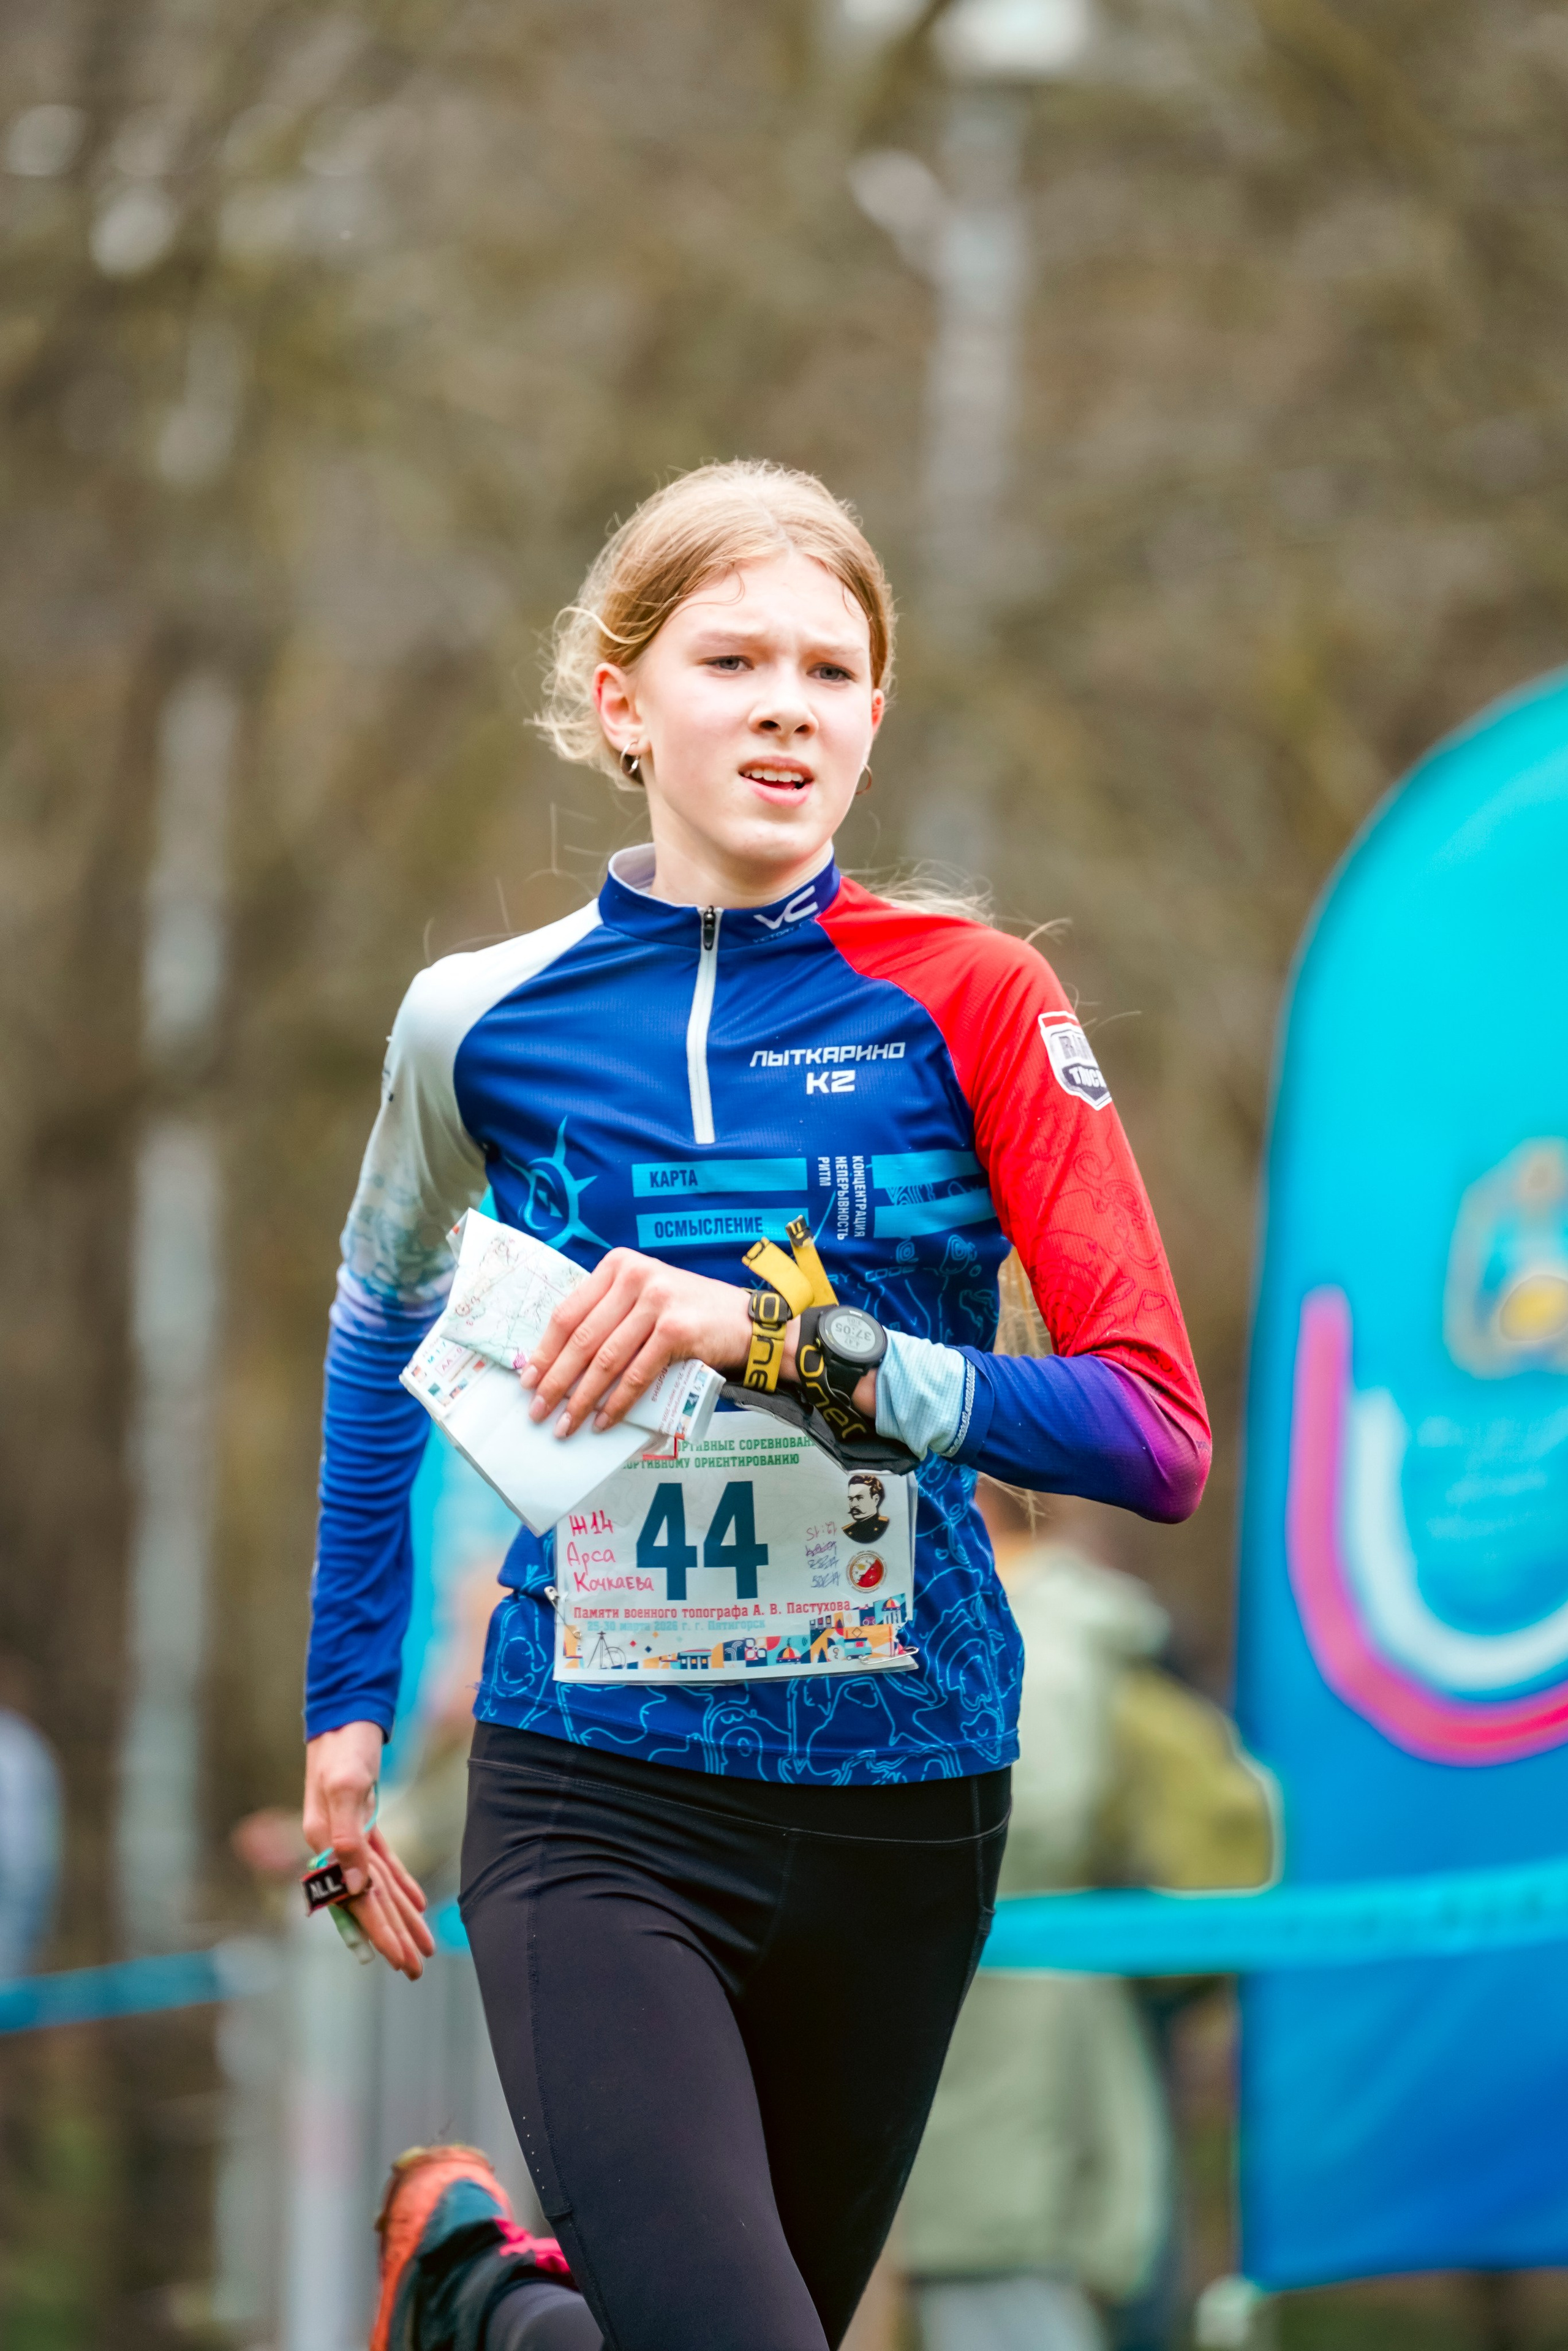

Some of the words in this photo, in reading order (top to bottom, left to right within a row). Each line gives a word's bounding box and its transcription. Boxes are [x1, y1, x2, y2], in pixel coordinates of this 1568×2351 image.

[750, 1042, 906, 1068] ЛЫТКАРИНО
[649, 1169, 699, 1188] КАРТА
[818, 1157, 832, 1187] РИТМ
[835, 1156, 850, 1240] НЕПЕРЫВНОСТЬ
[852, 1155, 867, 1237] КОНЦЕНТРАЦИЯ
[654, 1217, 764, 1239] ОСМЫСЛЕНИЕ
[739, 1436, 815, 1450] СОРЕВНОВАН
[695, 1454, 799, 1468] ОРИЕНТИРОВАНИЮ
[636, 1480, 769, 1601] 44
[573, 1607, 619, 1619] Памяти
[624, 1606, 677, 1618] военного
[682, 1604, 748, 1620] топографа
[786, 1594, 851, 1615] Пастухова
